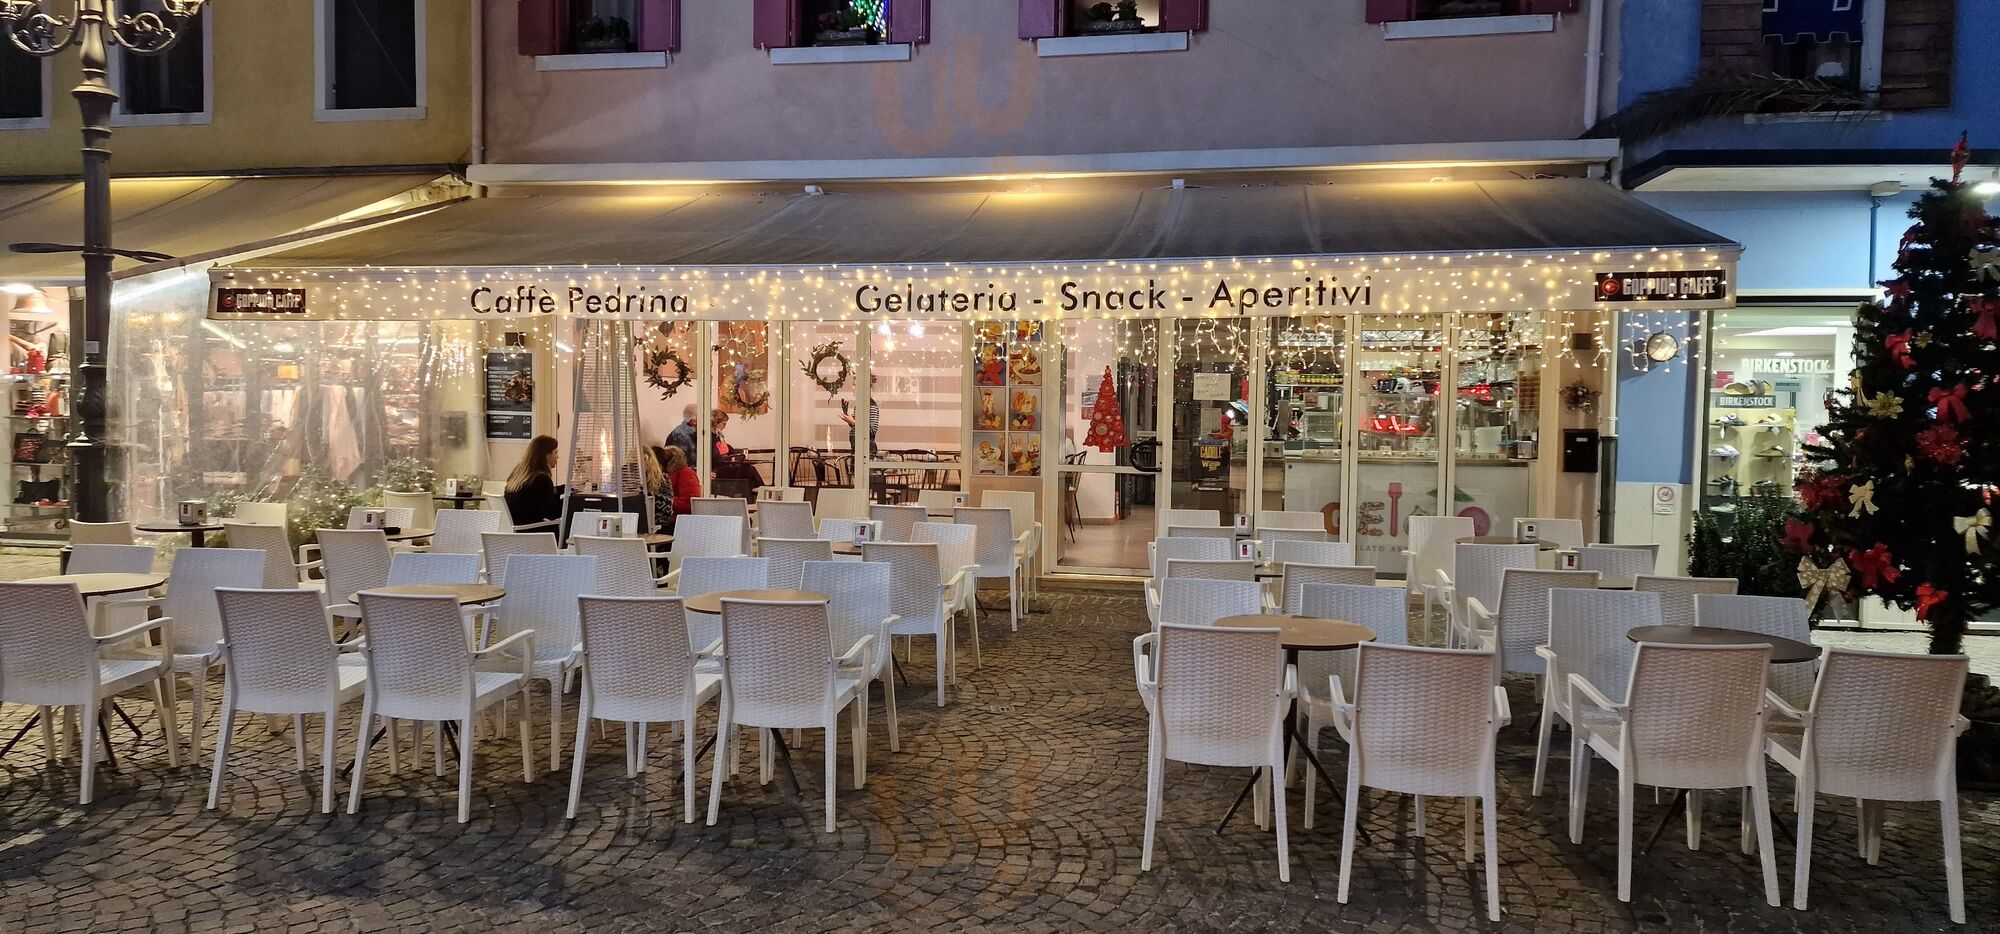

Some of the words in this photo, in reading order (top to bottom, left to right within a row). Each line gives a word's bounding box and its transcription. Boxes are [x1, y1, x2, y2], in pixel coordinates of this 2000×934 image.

[470, 286, 556, 314] Caffè
[568, 285, 689, 313] Pedrina
[855, 283, 1018, 313] Gelateria
[1060, 280, 1166, 311] Snack
[1208, 275, 1372, 316] Aperitivi
[1741, 358, 1831, 374] BIRKENSTOCK
[1719, 396, 1774, 406] BIRKENSTOCK
